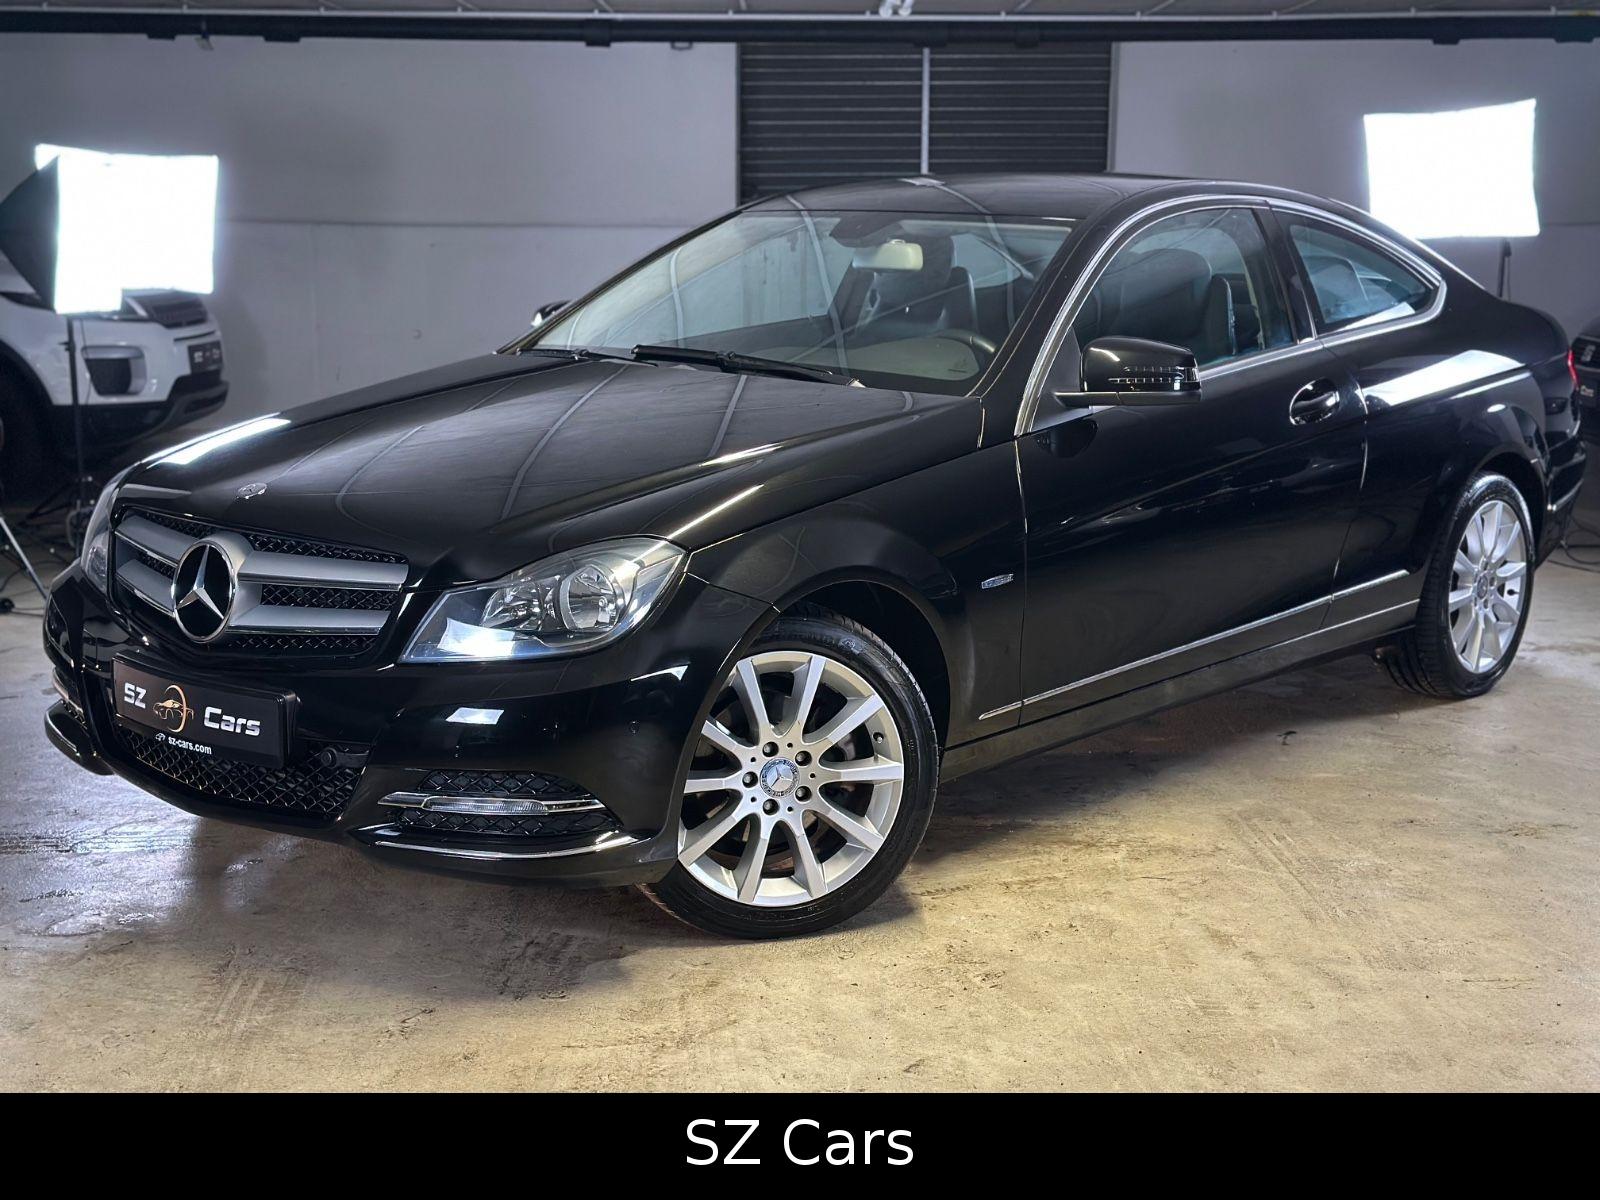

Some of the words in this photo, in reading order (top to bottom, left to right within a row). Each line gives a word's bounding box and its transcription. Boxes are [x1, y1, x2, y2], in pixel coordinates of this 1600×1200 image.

[124, 682, 147, 709] SZ
[203, 706, 261, 736] Cars
[168, 736, 212, 755] sz-cars.com
